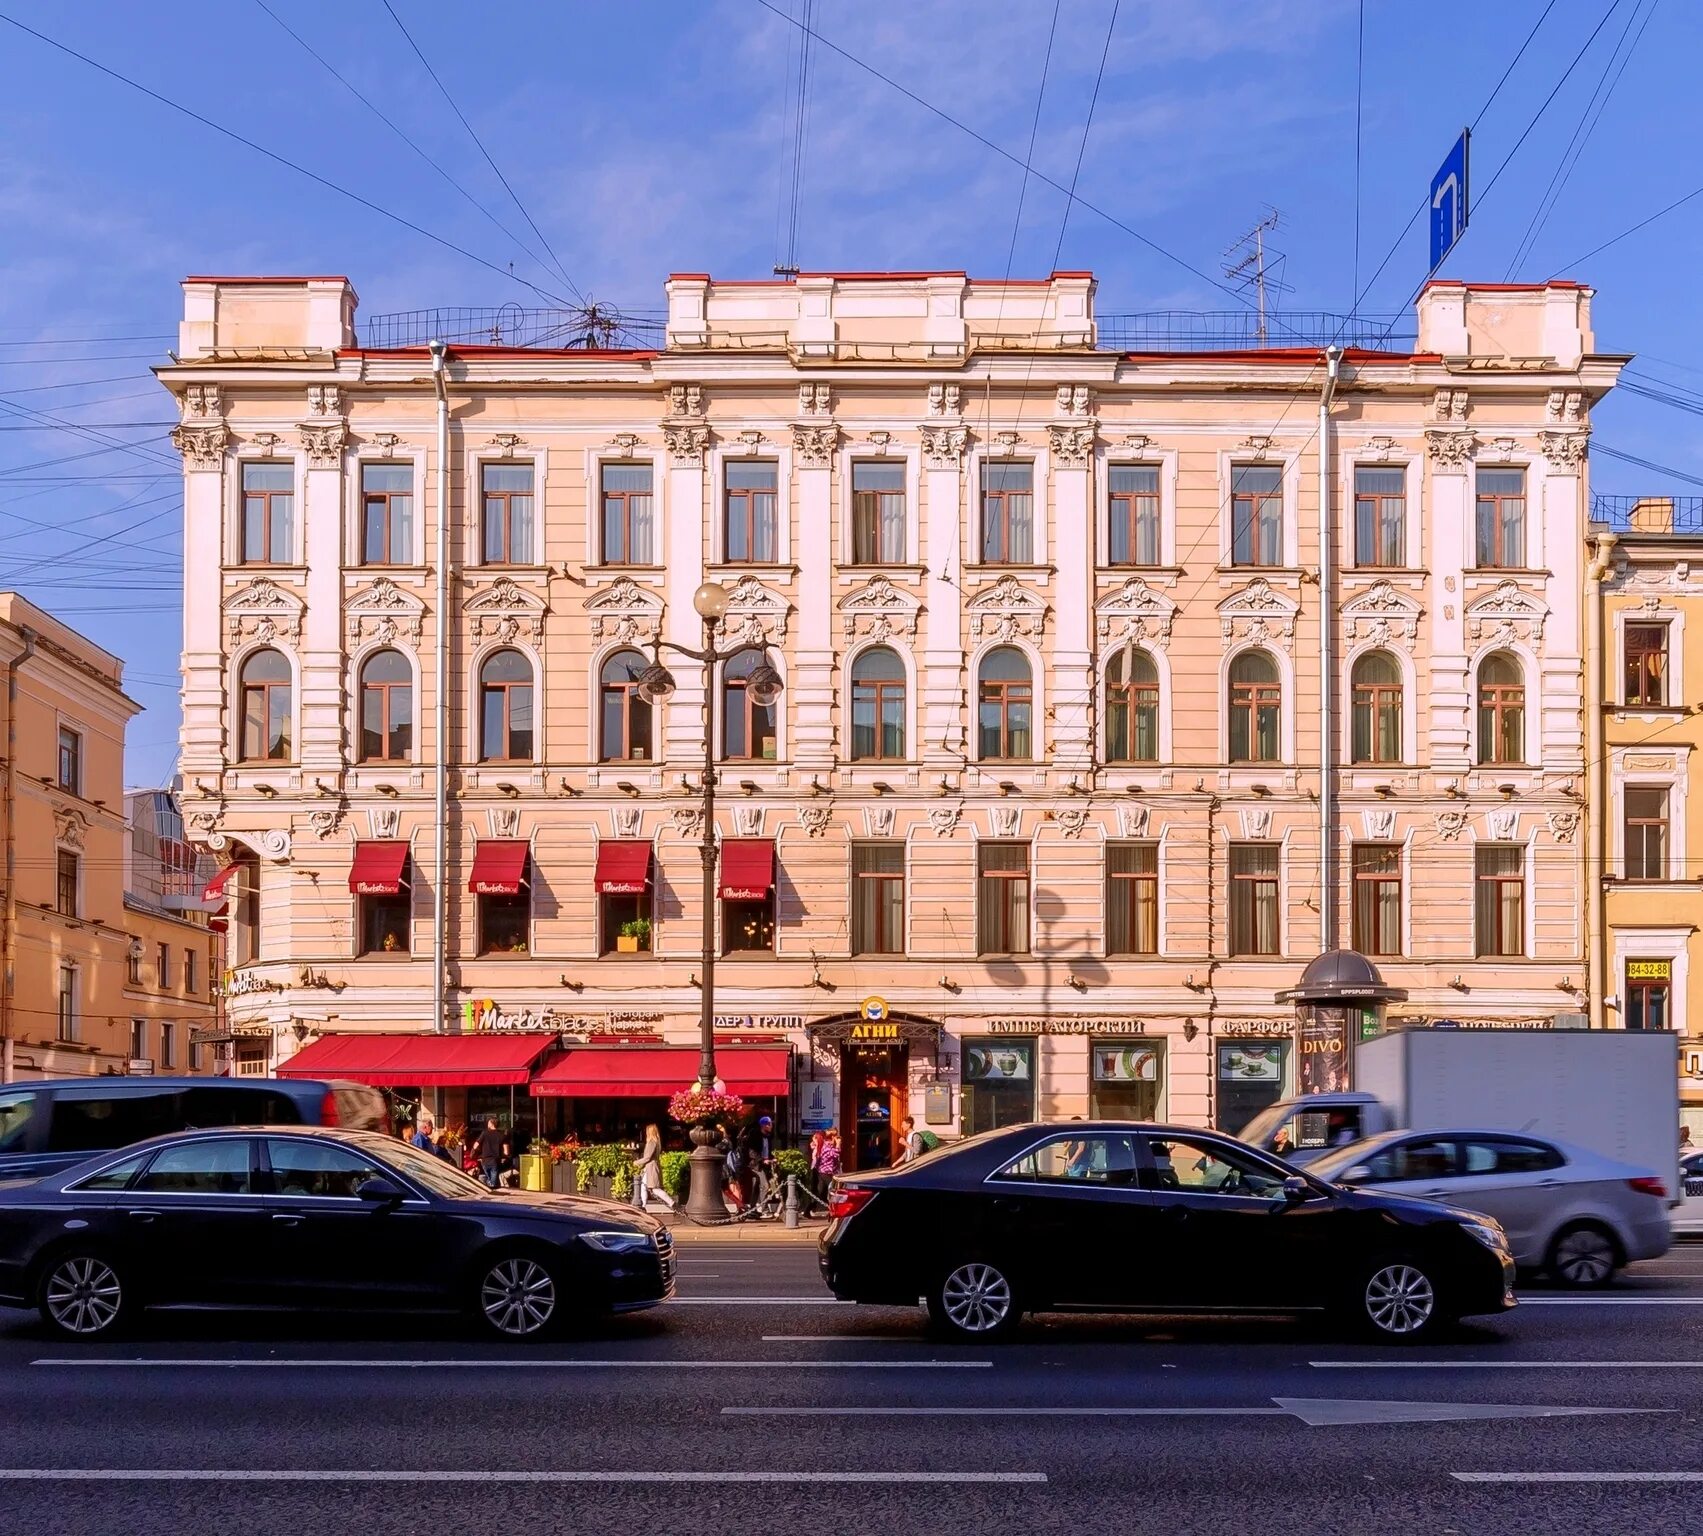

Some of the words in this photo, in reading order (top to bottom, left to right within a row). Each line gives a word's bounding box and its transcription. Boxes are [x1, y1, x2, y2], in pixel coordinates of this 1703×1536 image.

[1626, 964, 1668, 975] 984-32-88
[758, 1015, 799, 1027] ГРУПП
[988, 1020, 1144, 1033] ИМПЕРАТОРСКИЙ
[1222, 1020, 1293, 1033] ФАРФОР
[851, 1025, 898, 1038] АГНИ
